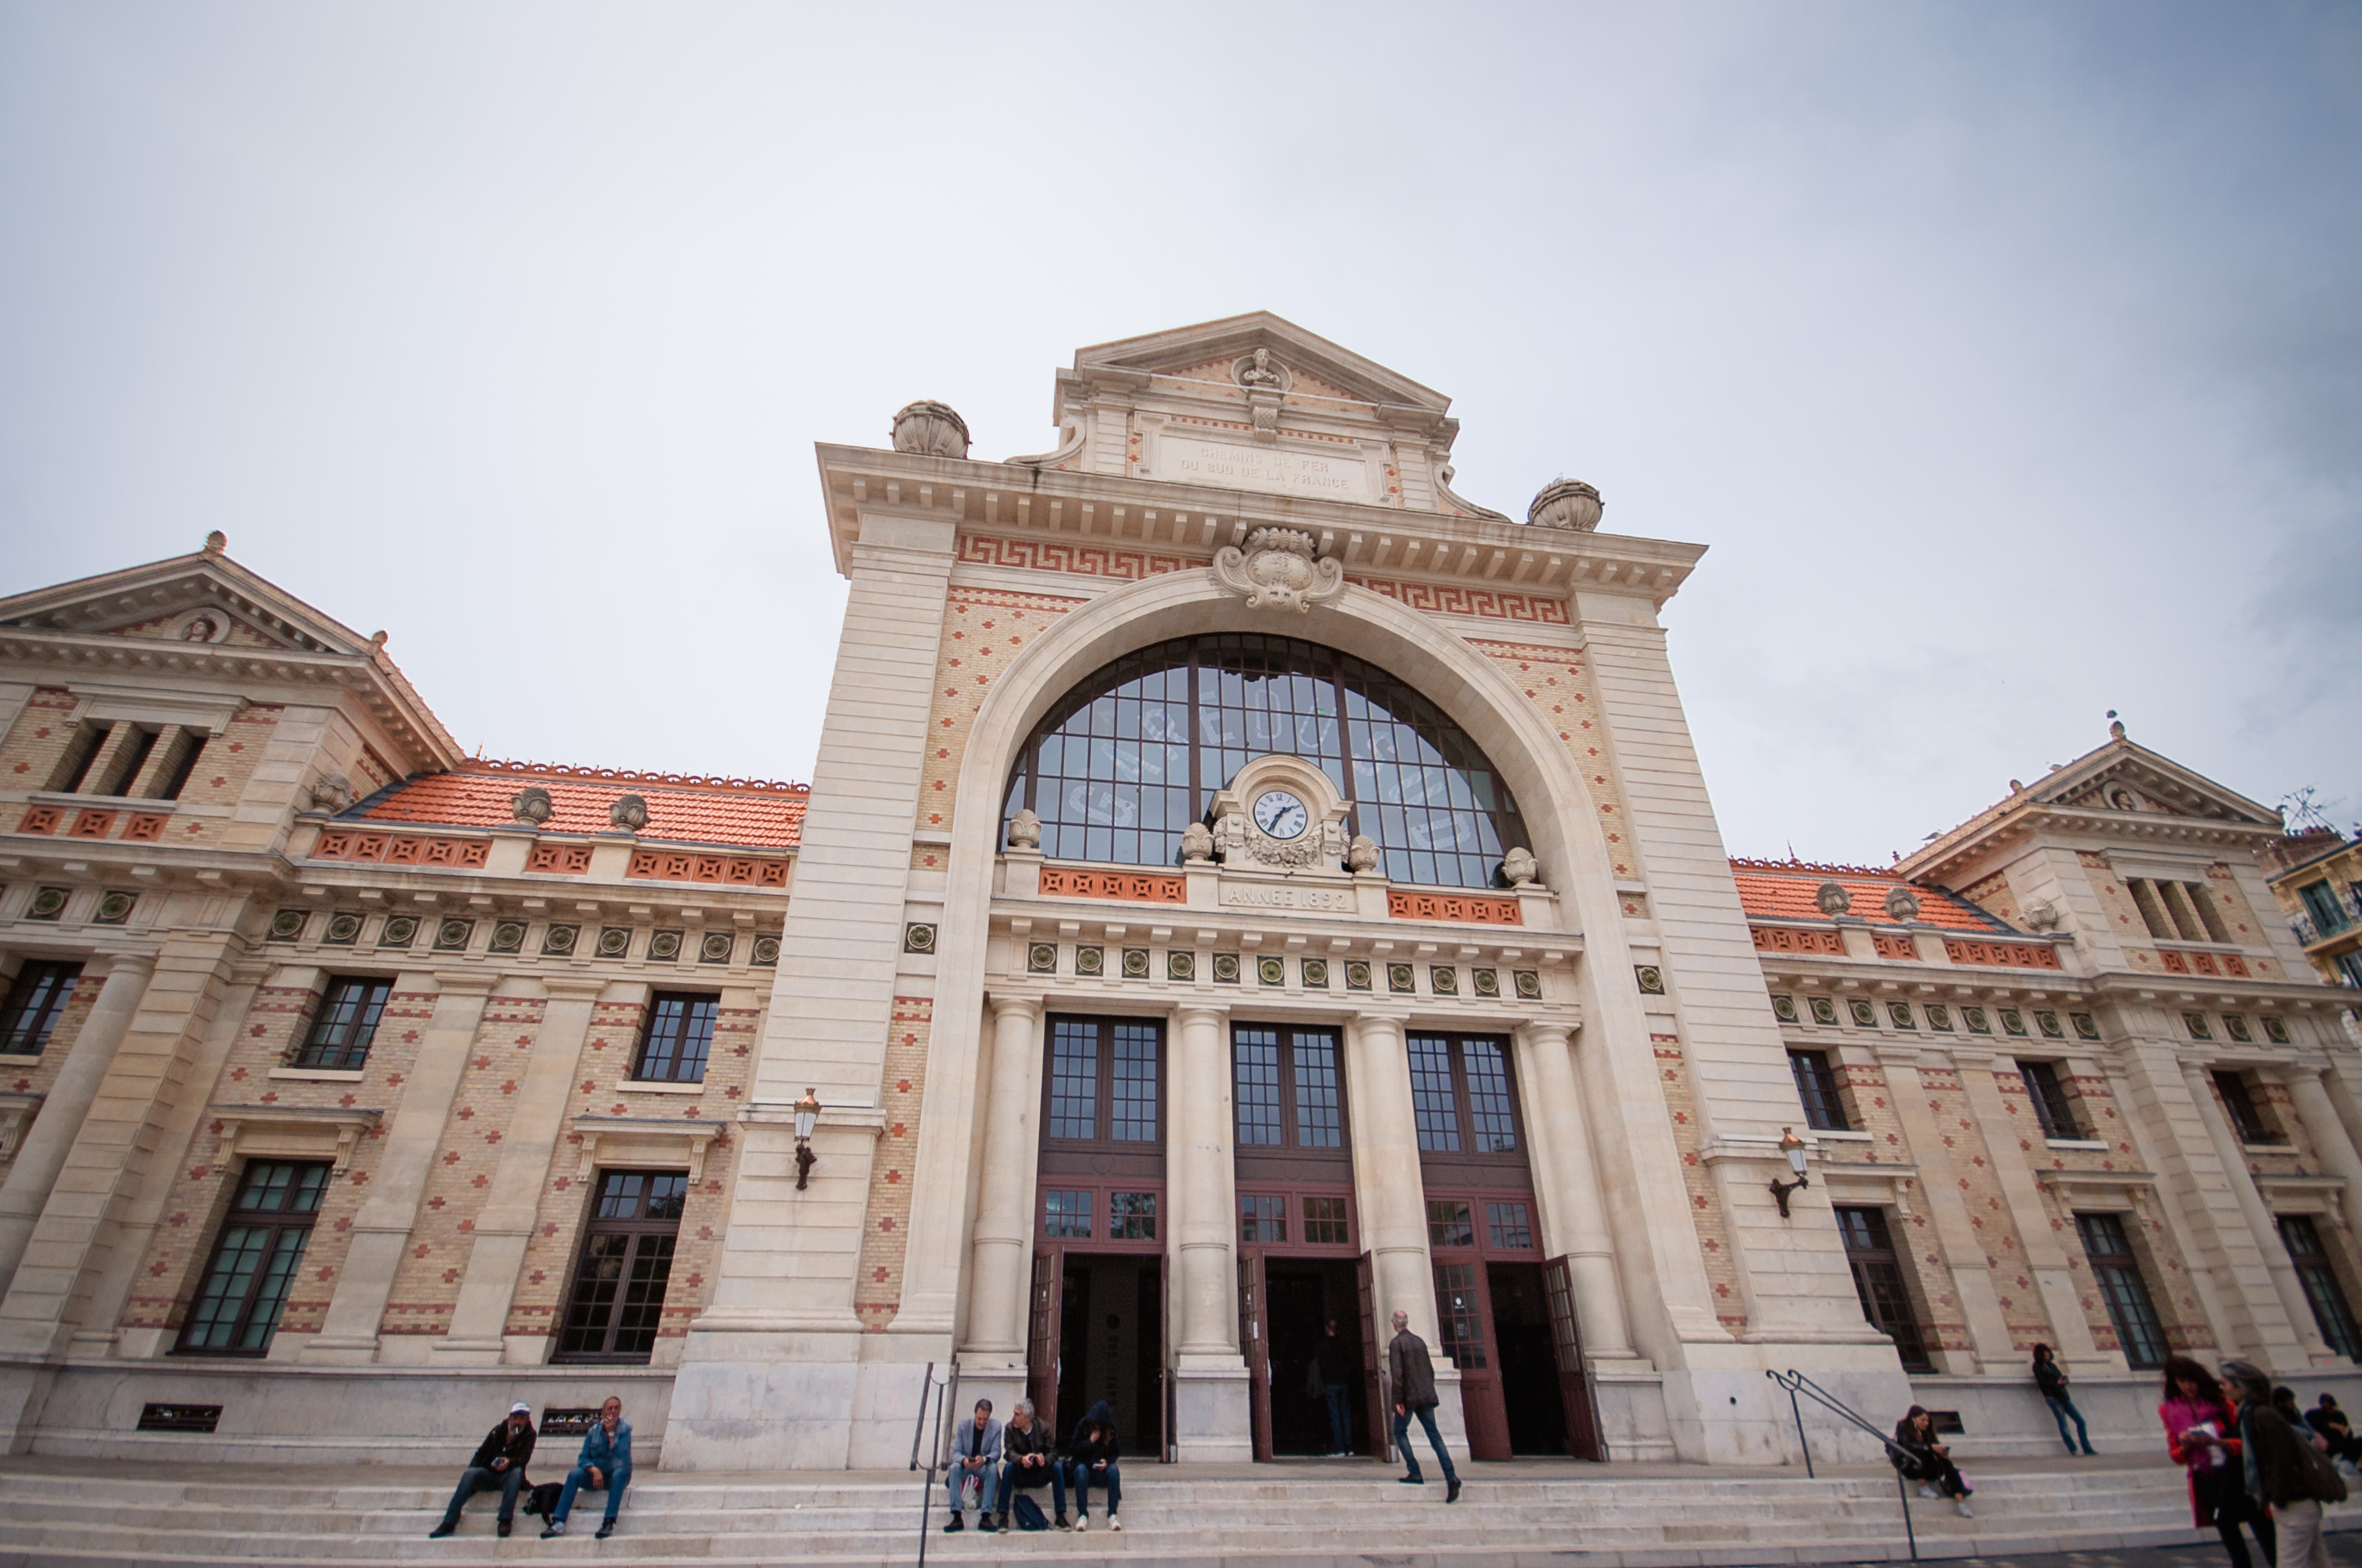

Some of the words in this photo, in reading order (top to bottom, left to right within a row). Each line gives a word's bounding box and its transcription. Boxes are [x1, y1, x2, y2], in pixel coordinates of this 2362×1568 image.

[1200, 447, 1263, 465] CHEMINS
[1273, 457, 1291, 468] DE
[1302, 460, 1330, 473] FER
[1181, 459, 1199, 471] DU
[1206, 463, 1234, 475] SUD
[1241, 466, 1260, 480] DE
[1265, 469, 1286, 482] LA
[1292, 474, 1350, 490] FRANCE
[1069, 690, 1237, 827] GARE
[1255, 689, 1337, 749] DU
[1352, 731, 1471, 850] SUD
[1228, 886, 1294, 907] ANNEE
[1301, 891, 1347, 910] 1892
[1106, 1335, 1118, 1359] SUD
[1106, 1376, 1118, 1407] GARE
